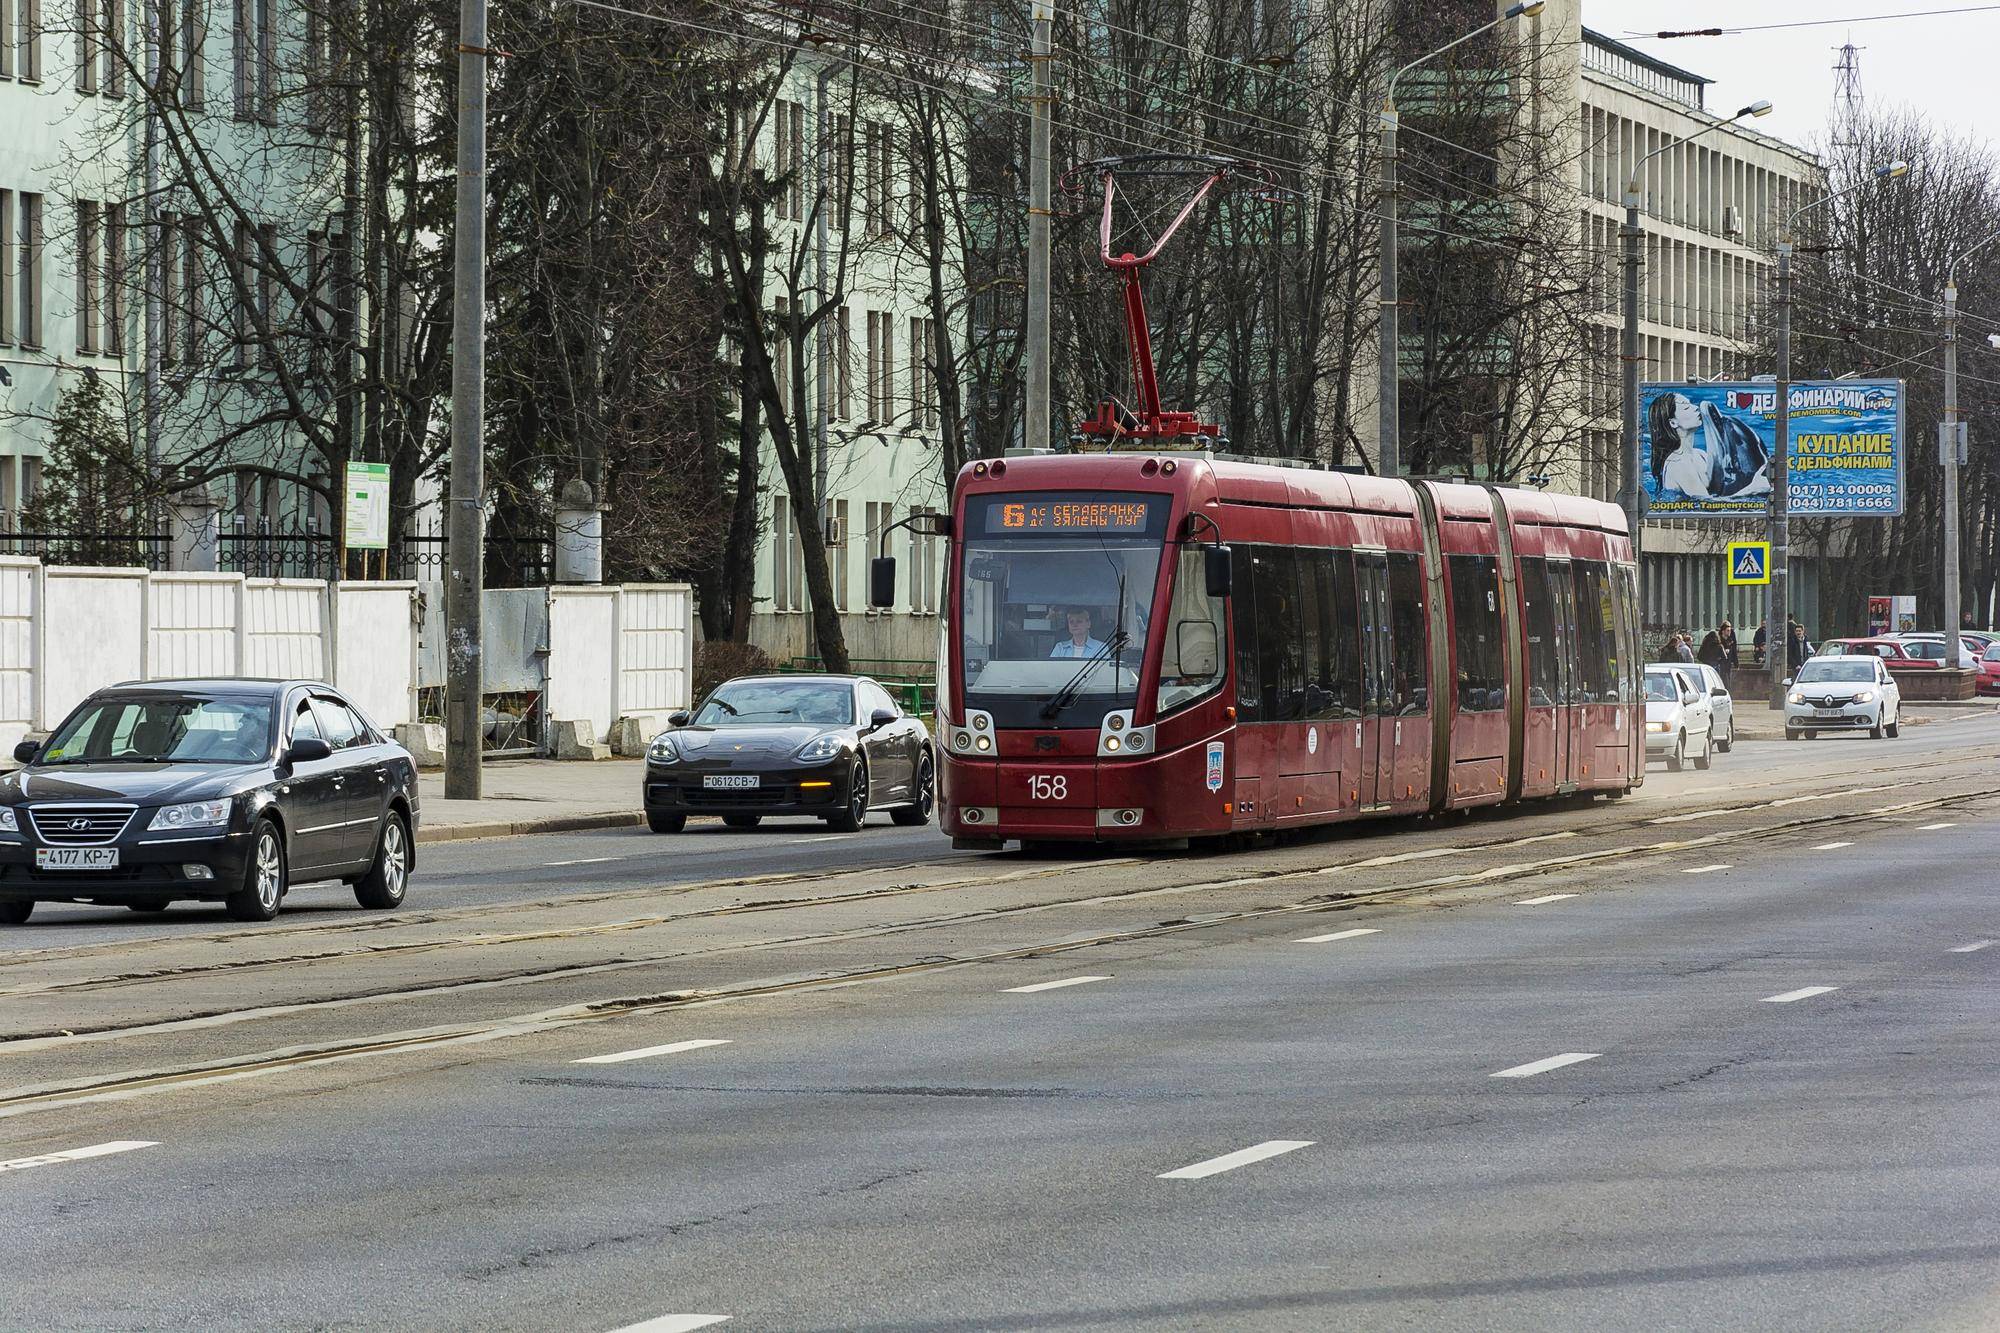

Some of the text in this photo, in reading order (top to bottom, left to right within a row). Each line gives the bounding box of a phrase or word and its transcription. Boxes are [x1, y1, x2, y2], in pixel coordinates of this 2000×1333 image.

[1726, 390, 1737, 409] Я
[1797, 434, 1892, 454] КУПАНИЕ
[1787, 456, 1892, 472] С ДЕЛЬФИНАМИ
[1788, 485, 1892, 496] (017) 34 00004
[1053, 504, 1145, 516] СЕРАБРАНКА
[1700, 501, 1765, 510] Ташкентская
[1788, 497, 1892, 509] (044) 781 6666
[1003, 504, 1025, 527] 6
[1115, 515, 1142, 526] ЛУГ
[1027, 775, 1068, 800] 158
[48, 850, 79, 864] 4177
[83, 850, 116, 864] KP-7
